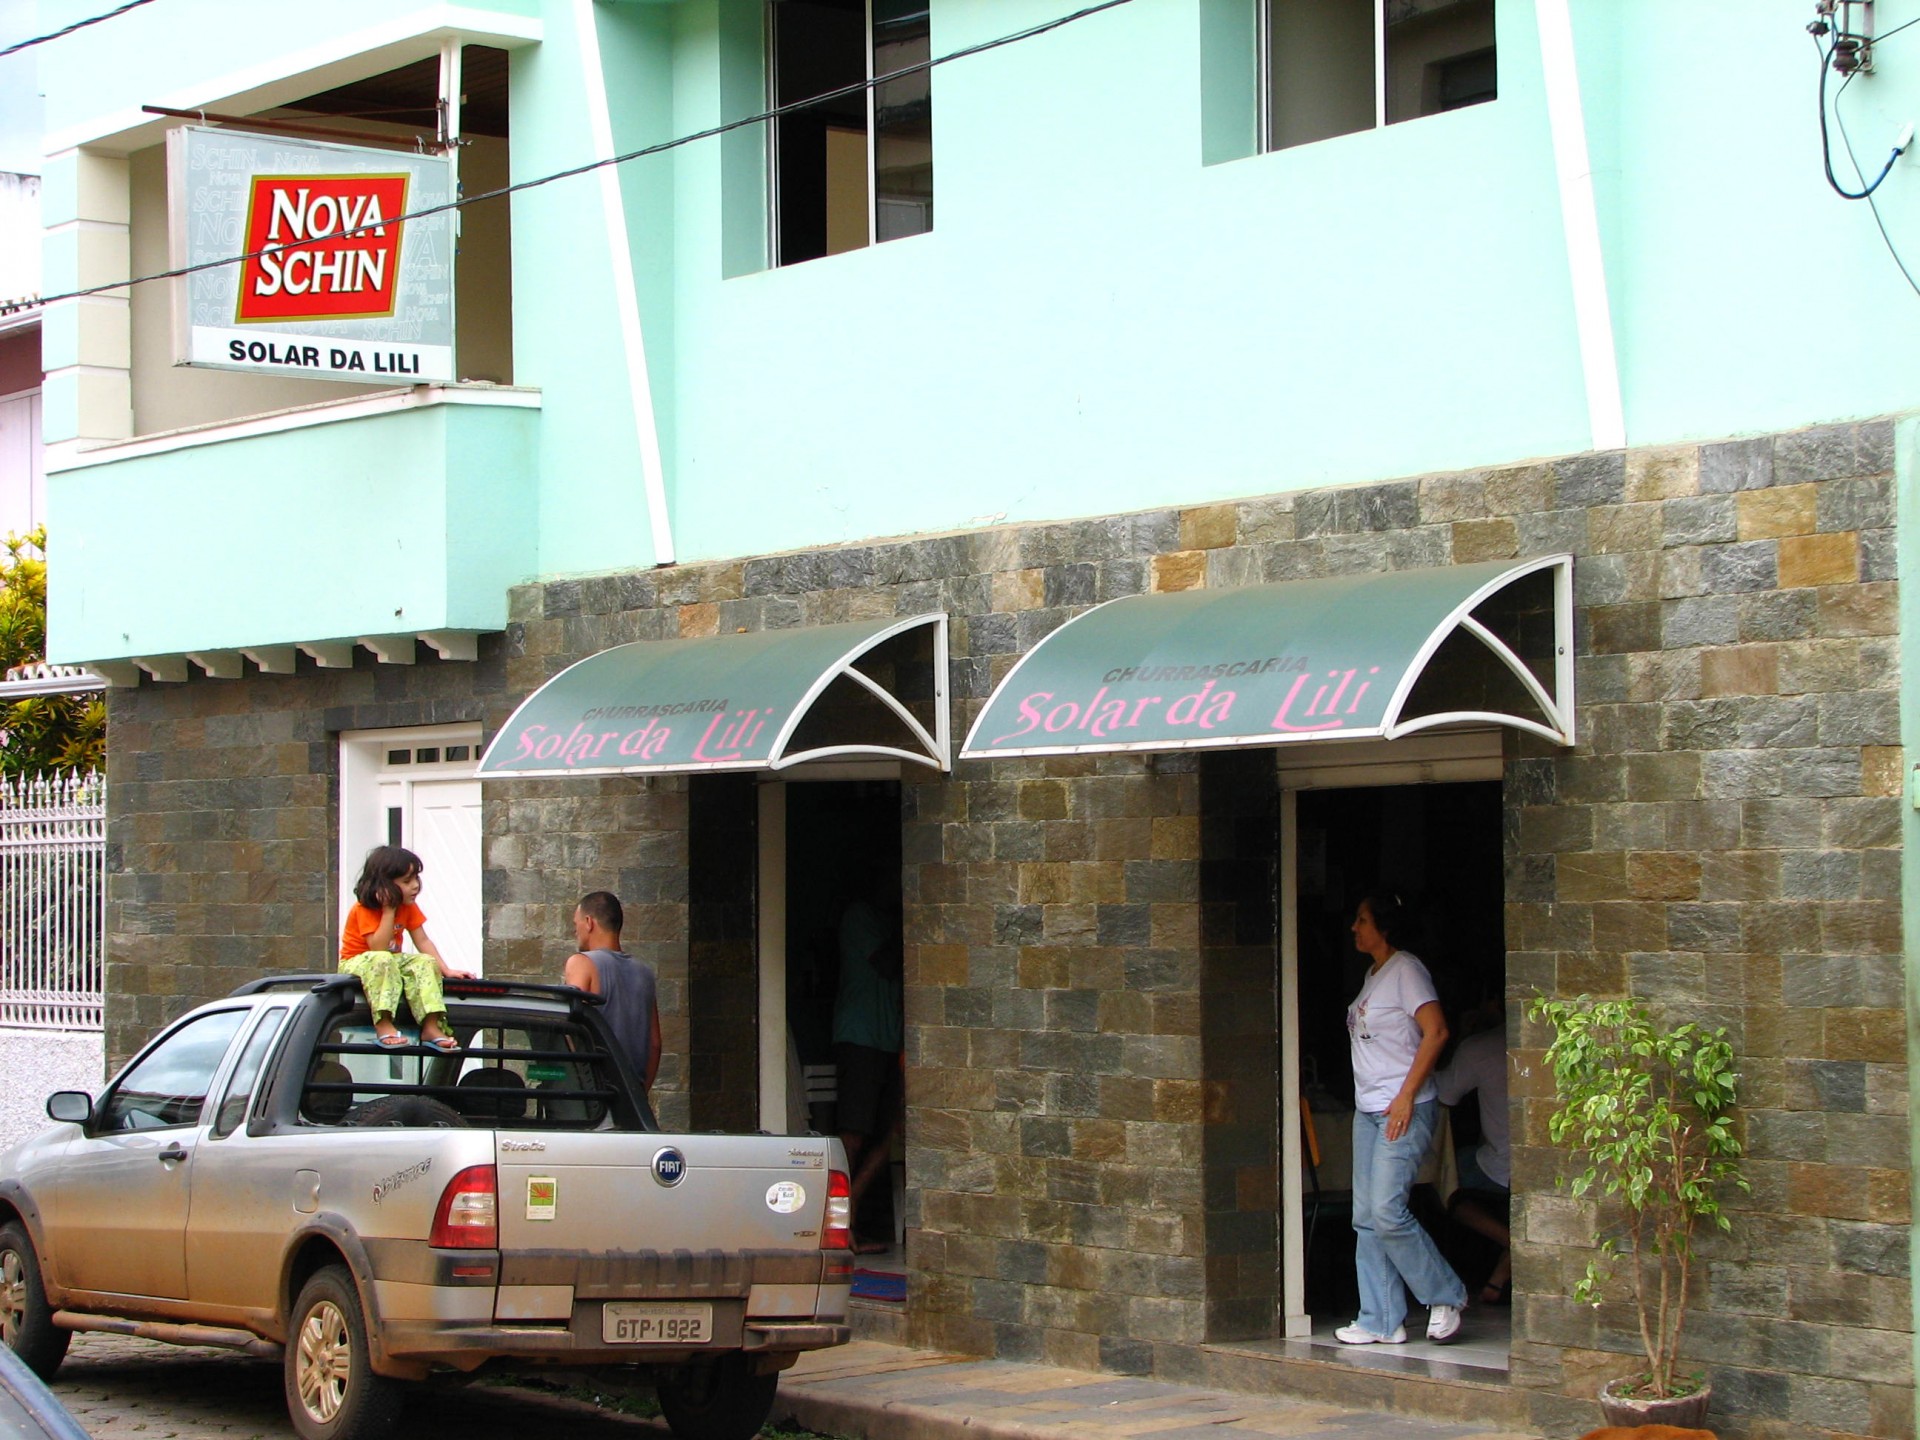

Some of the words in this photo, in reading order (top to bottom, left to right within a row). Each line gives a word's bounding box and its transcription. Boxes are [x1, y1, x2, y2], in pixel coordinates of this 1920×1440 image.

[267, 188, 386, 241] NOVA
[255, 243, 387, 296] SCHIN
[229, 340, 320, 368] SOLAR
[330, 349, 366, 371] DA
[374, 352, 420, 374] LILI
[1102, 656, 1310, 684] CHURRASCARIA
[582, 698, 729, 721] CHURRASCARIA
[992, 686, 1162, 745] Solar
[1166, 679, 1237, 729] da
[1271, 666, 1380, 732] Lili
[496, 721, 619, 767] Solar
[618, 717, 671, 760] da
[692, 708, 774, 762] Lili
[501, 1138, 546, 1152] Strada
[659, 1160, 681, 1173] FIAT
